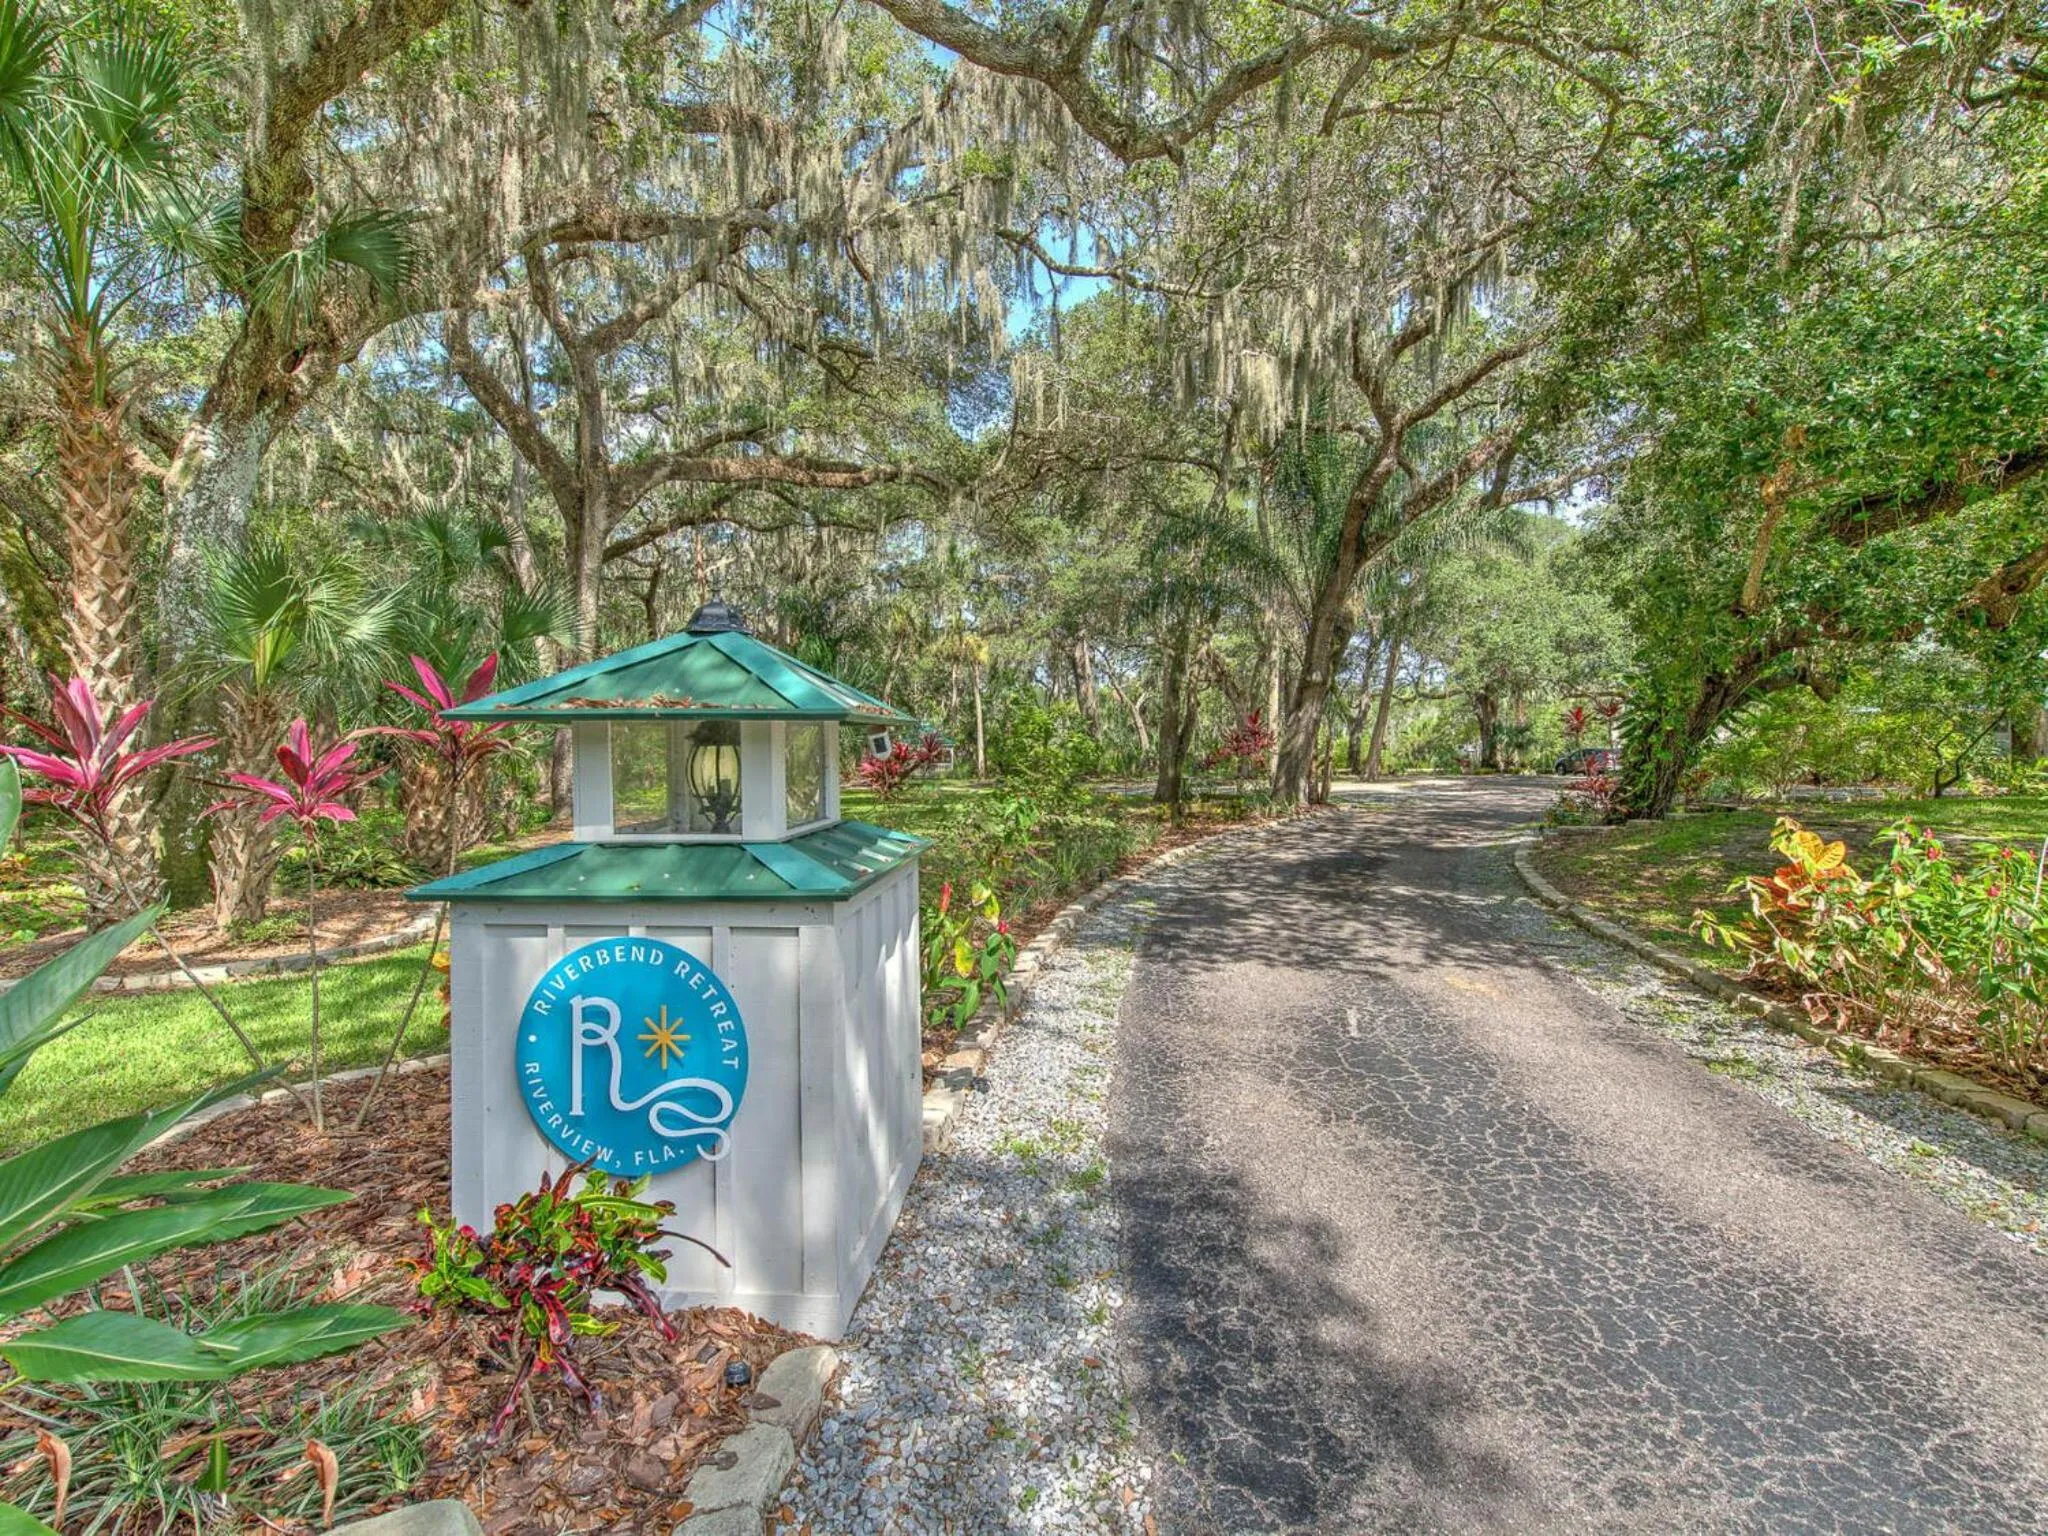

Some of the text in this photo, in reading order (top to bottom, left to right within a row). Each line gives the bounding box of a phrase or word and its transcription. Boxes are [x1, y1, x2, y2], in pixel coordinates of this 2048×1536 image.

[533, 946, 739, 1069] RIVERBEND RETREAT
[525, 1062, 685, 1168] RIVERVIEW, FLA.
